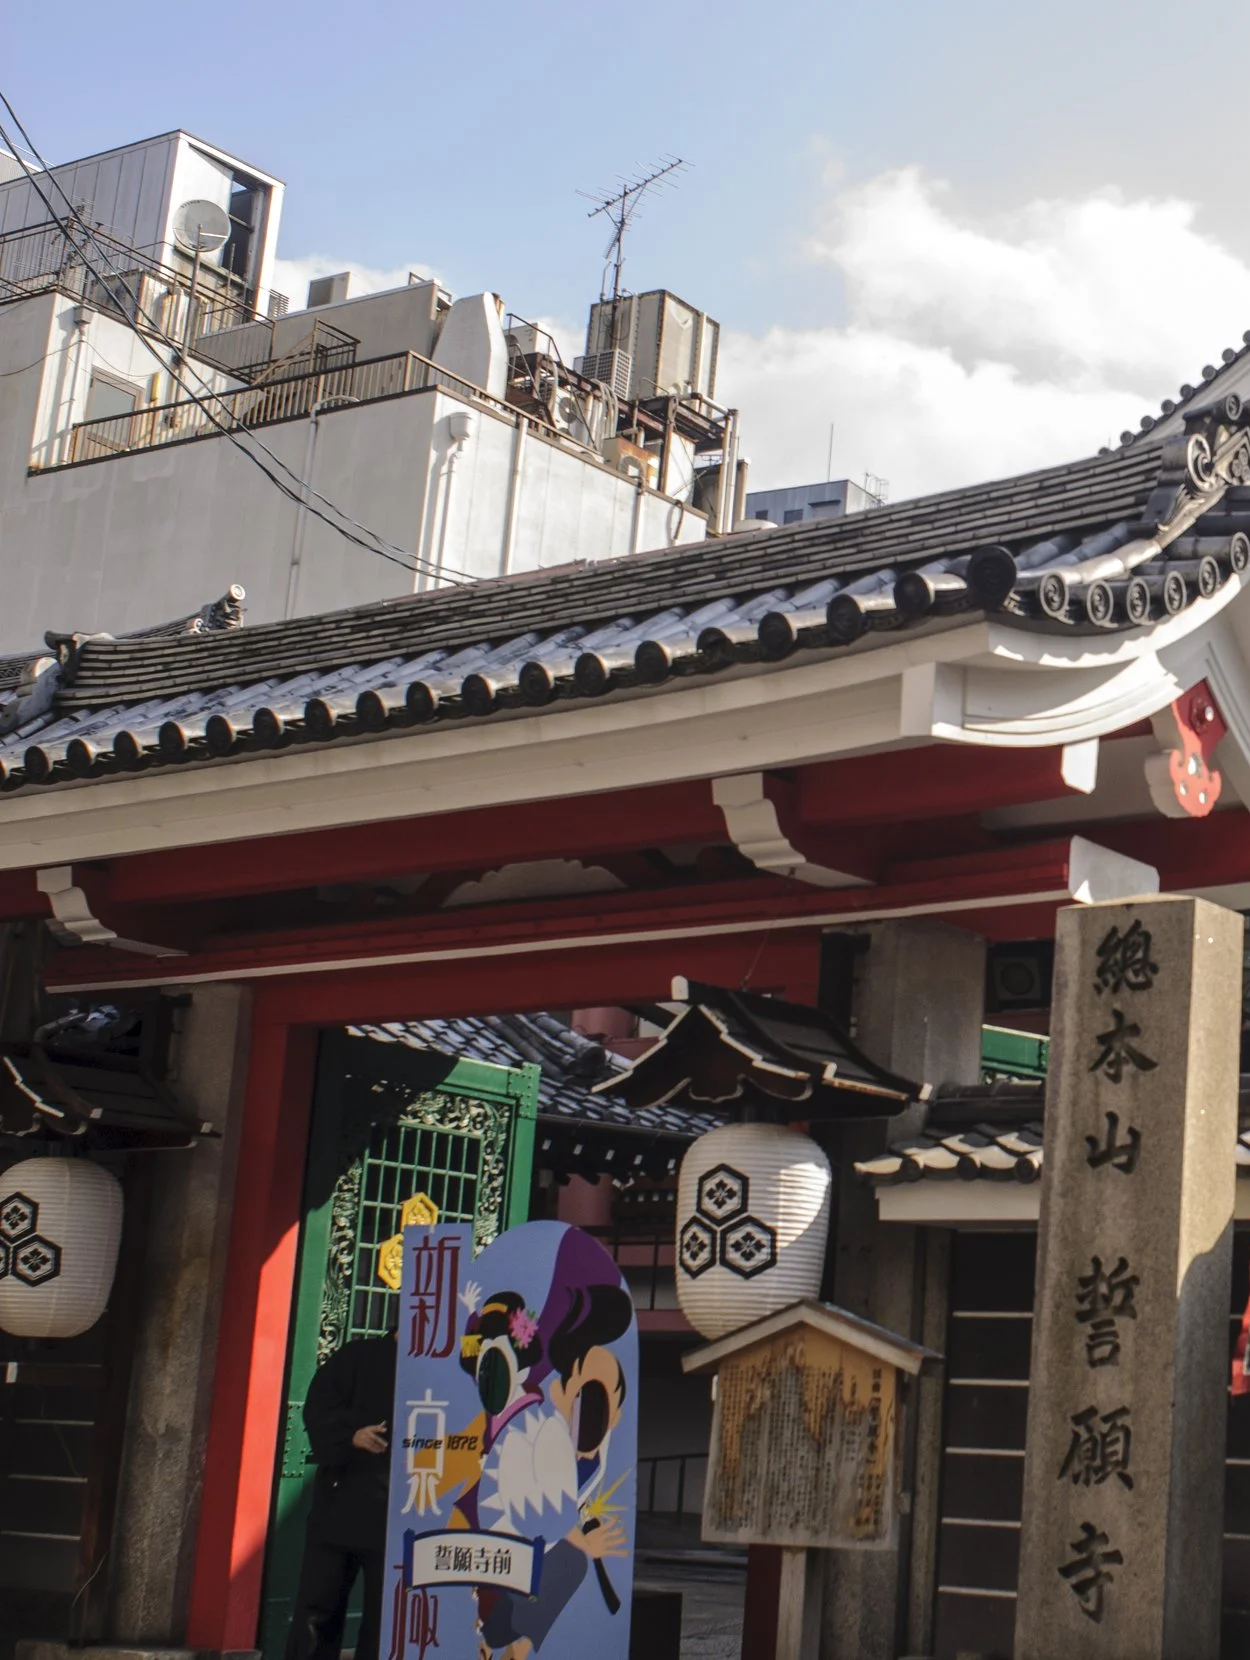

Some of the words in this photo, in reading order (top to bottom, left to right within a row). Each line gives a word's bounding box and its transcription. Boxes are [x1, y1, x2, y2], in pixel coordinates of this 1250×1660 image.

[1085, 920, 1159, 1175] 總本山
[402, 1434, 443, 1450] since
[447, 1435, 479, 1451] 1872
[1057, 1257, 1142, 1625] 誓願寺
[434, 1544, 513, 1575] 誓願寺前
